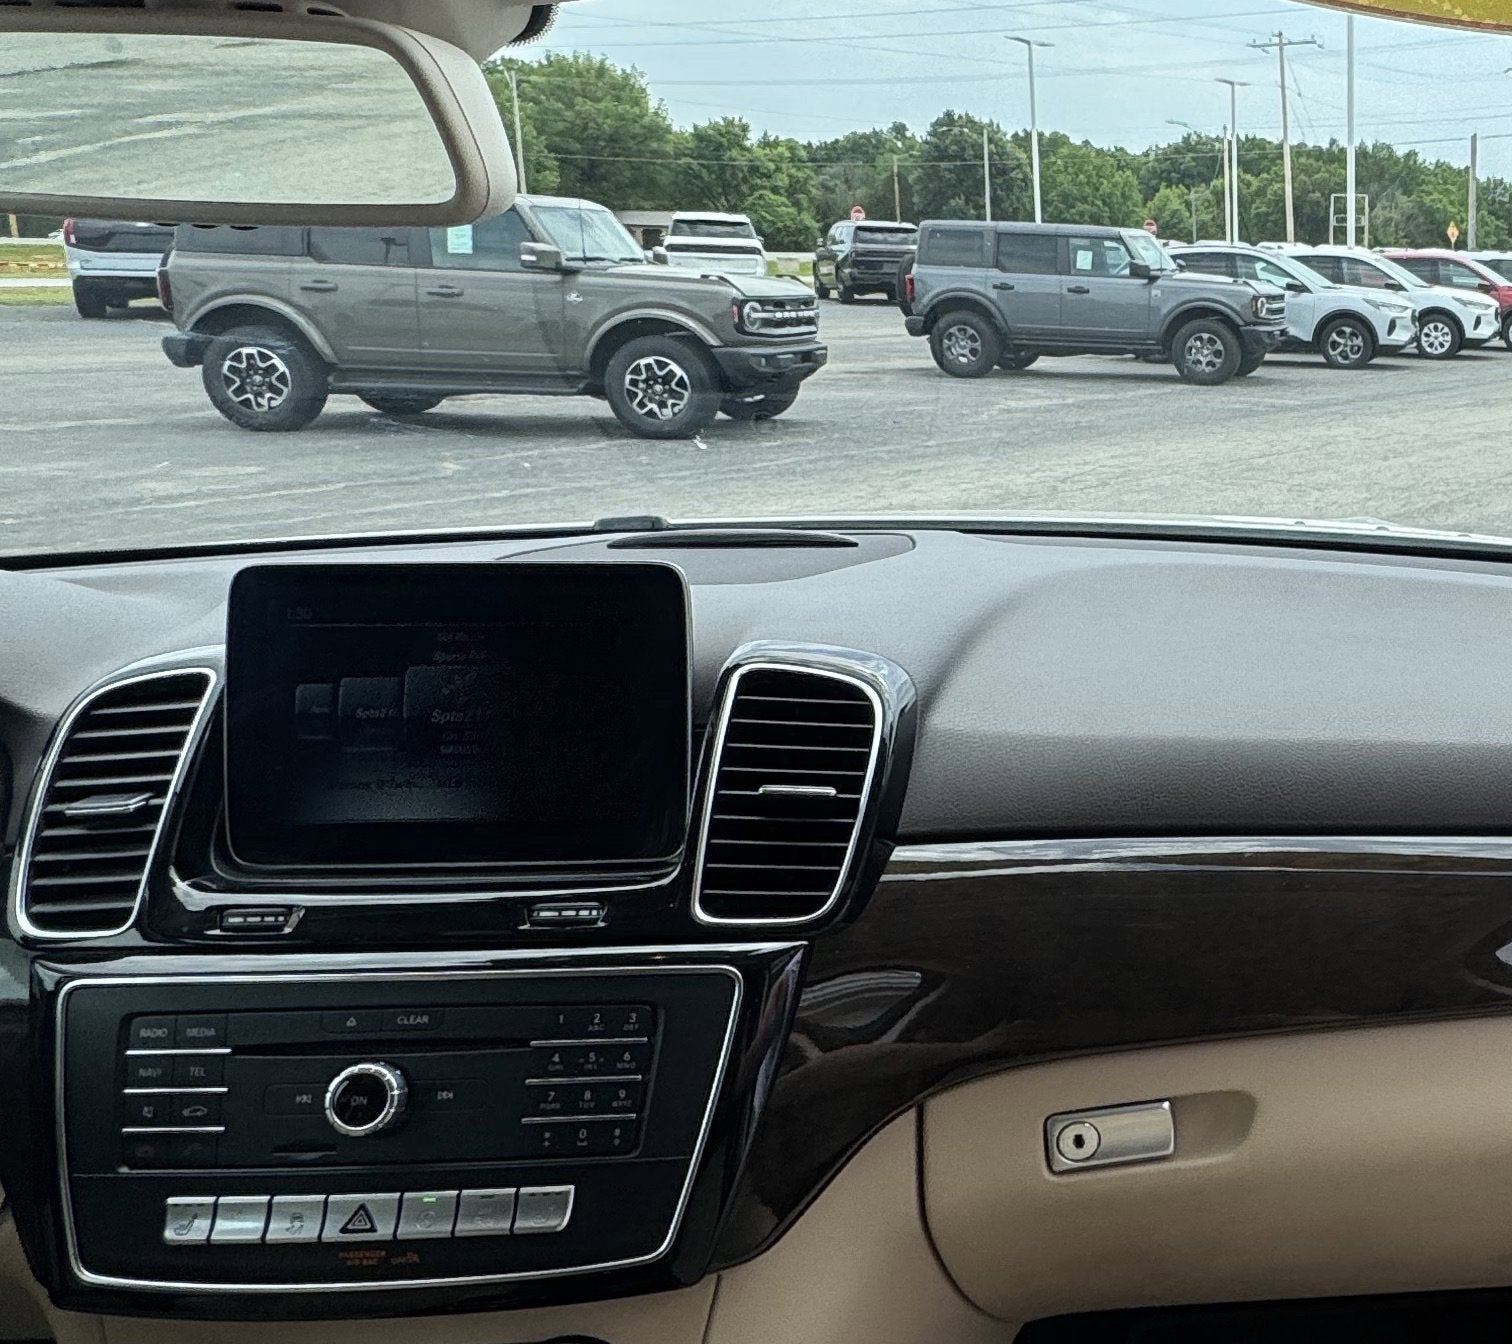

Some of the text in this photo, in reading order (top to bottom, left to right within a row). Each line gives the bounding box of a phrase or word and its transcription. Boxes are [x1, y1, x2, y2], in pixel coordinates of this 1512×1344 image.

[397, 1016, 430, 1025] CLEAR
[593, 1013, 601, 1023] 2
[628, 1013, 637, 1023] 3
[551, 1053, 560, 1062] 4
[588, 1052, 596, 1062] 5
[623, 1051, 631, 1061] 6
[190, 1067, 206, 1077] TEL
[547, 1091, 556, 1101] 7
[583, 1090, 591, 1101] 8
[618, 1089, 626, 1099] 9
[579, 1128, 587, 1139] 0
